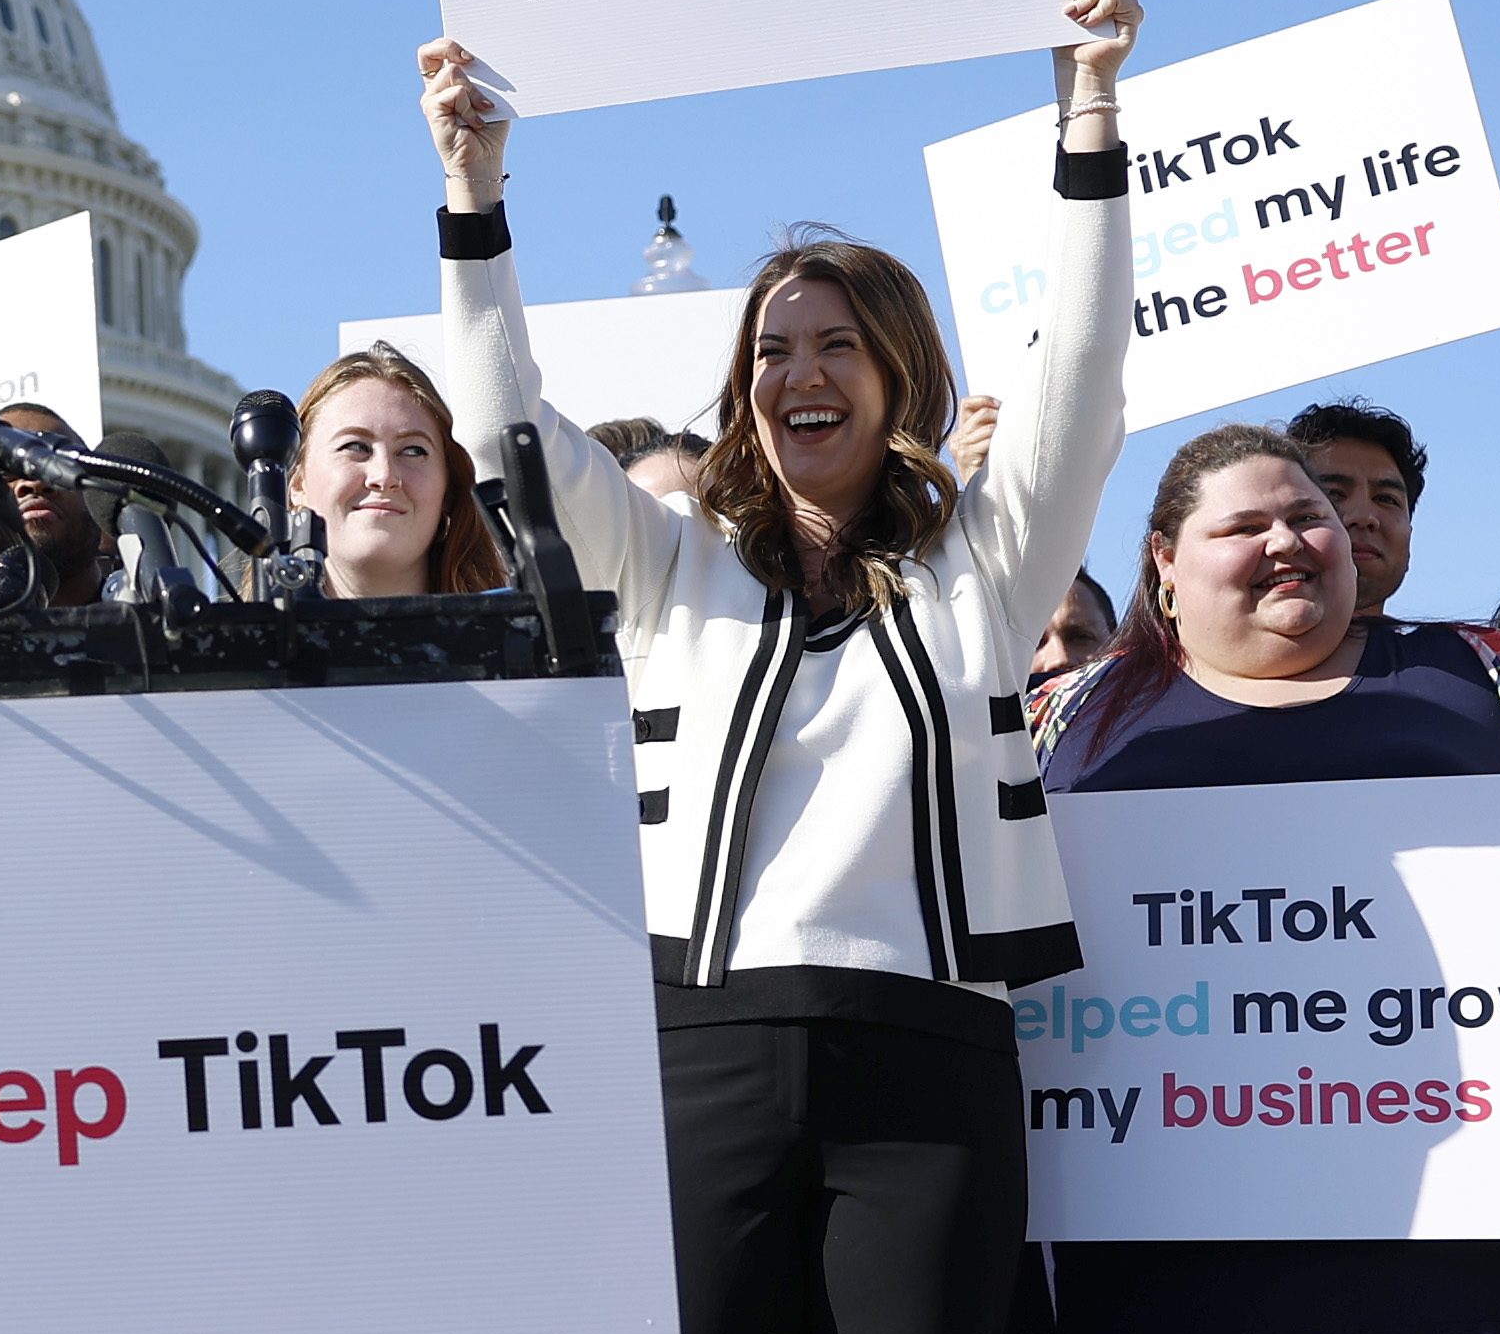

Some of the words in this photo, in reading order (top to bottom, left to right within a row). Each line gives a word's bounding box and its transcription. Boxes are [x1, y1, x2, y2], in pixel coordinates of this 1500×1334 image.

[1127, 117, 1301, 195] ikTok
[980, 198, 1239, 315] chged
[1255, 175, 1345, 229] my
[1363, 143, 1460, 196] life
[1133, 285, 1229, 338] the
[1242, 222, 1434, 305] better
[1133, 886, 1376, 946] TikTok
[1012, 981, 1209, 1053] elped
[1233, 990, 1346, 1034] me
[158, 1023, 551, 1132] TikTok
[1030, 1088, 1140, 1143] my
[1162, 1066, 1492, 1128] business
